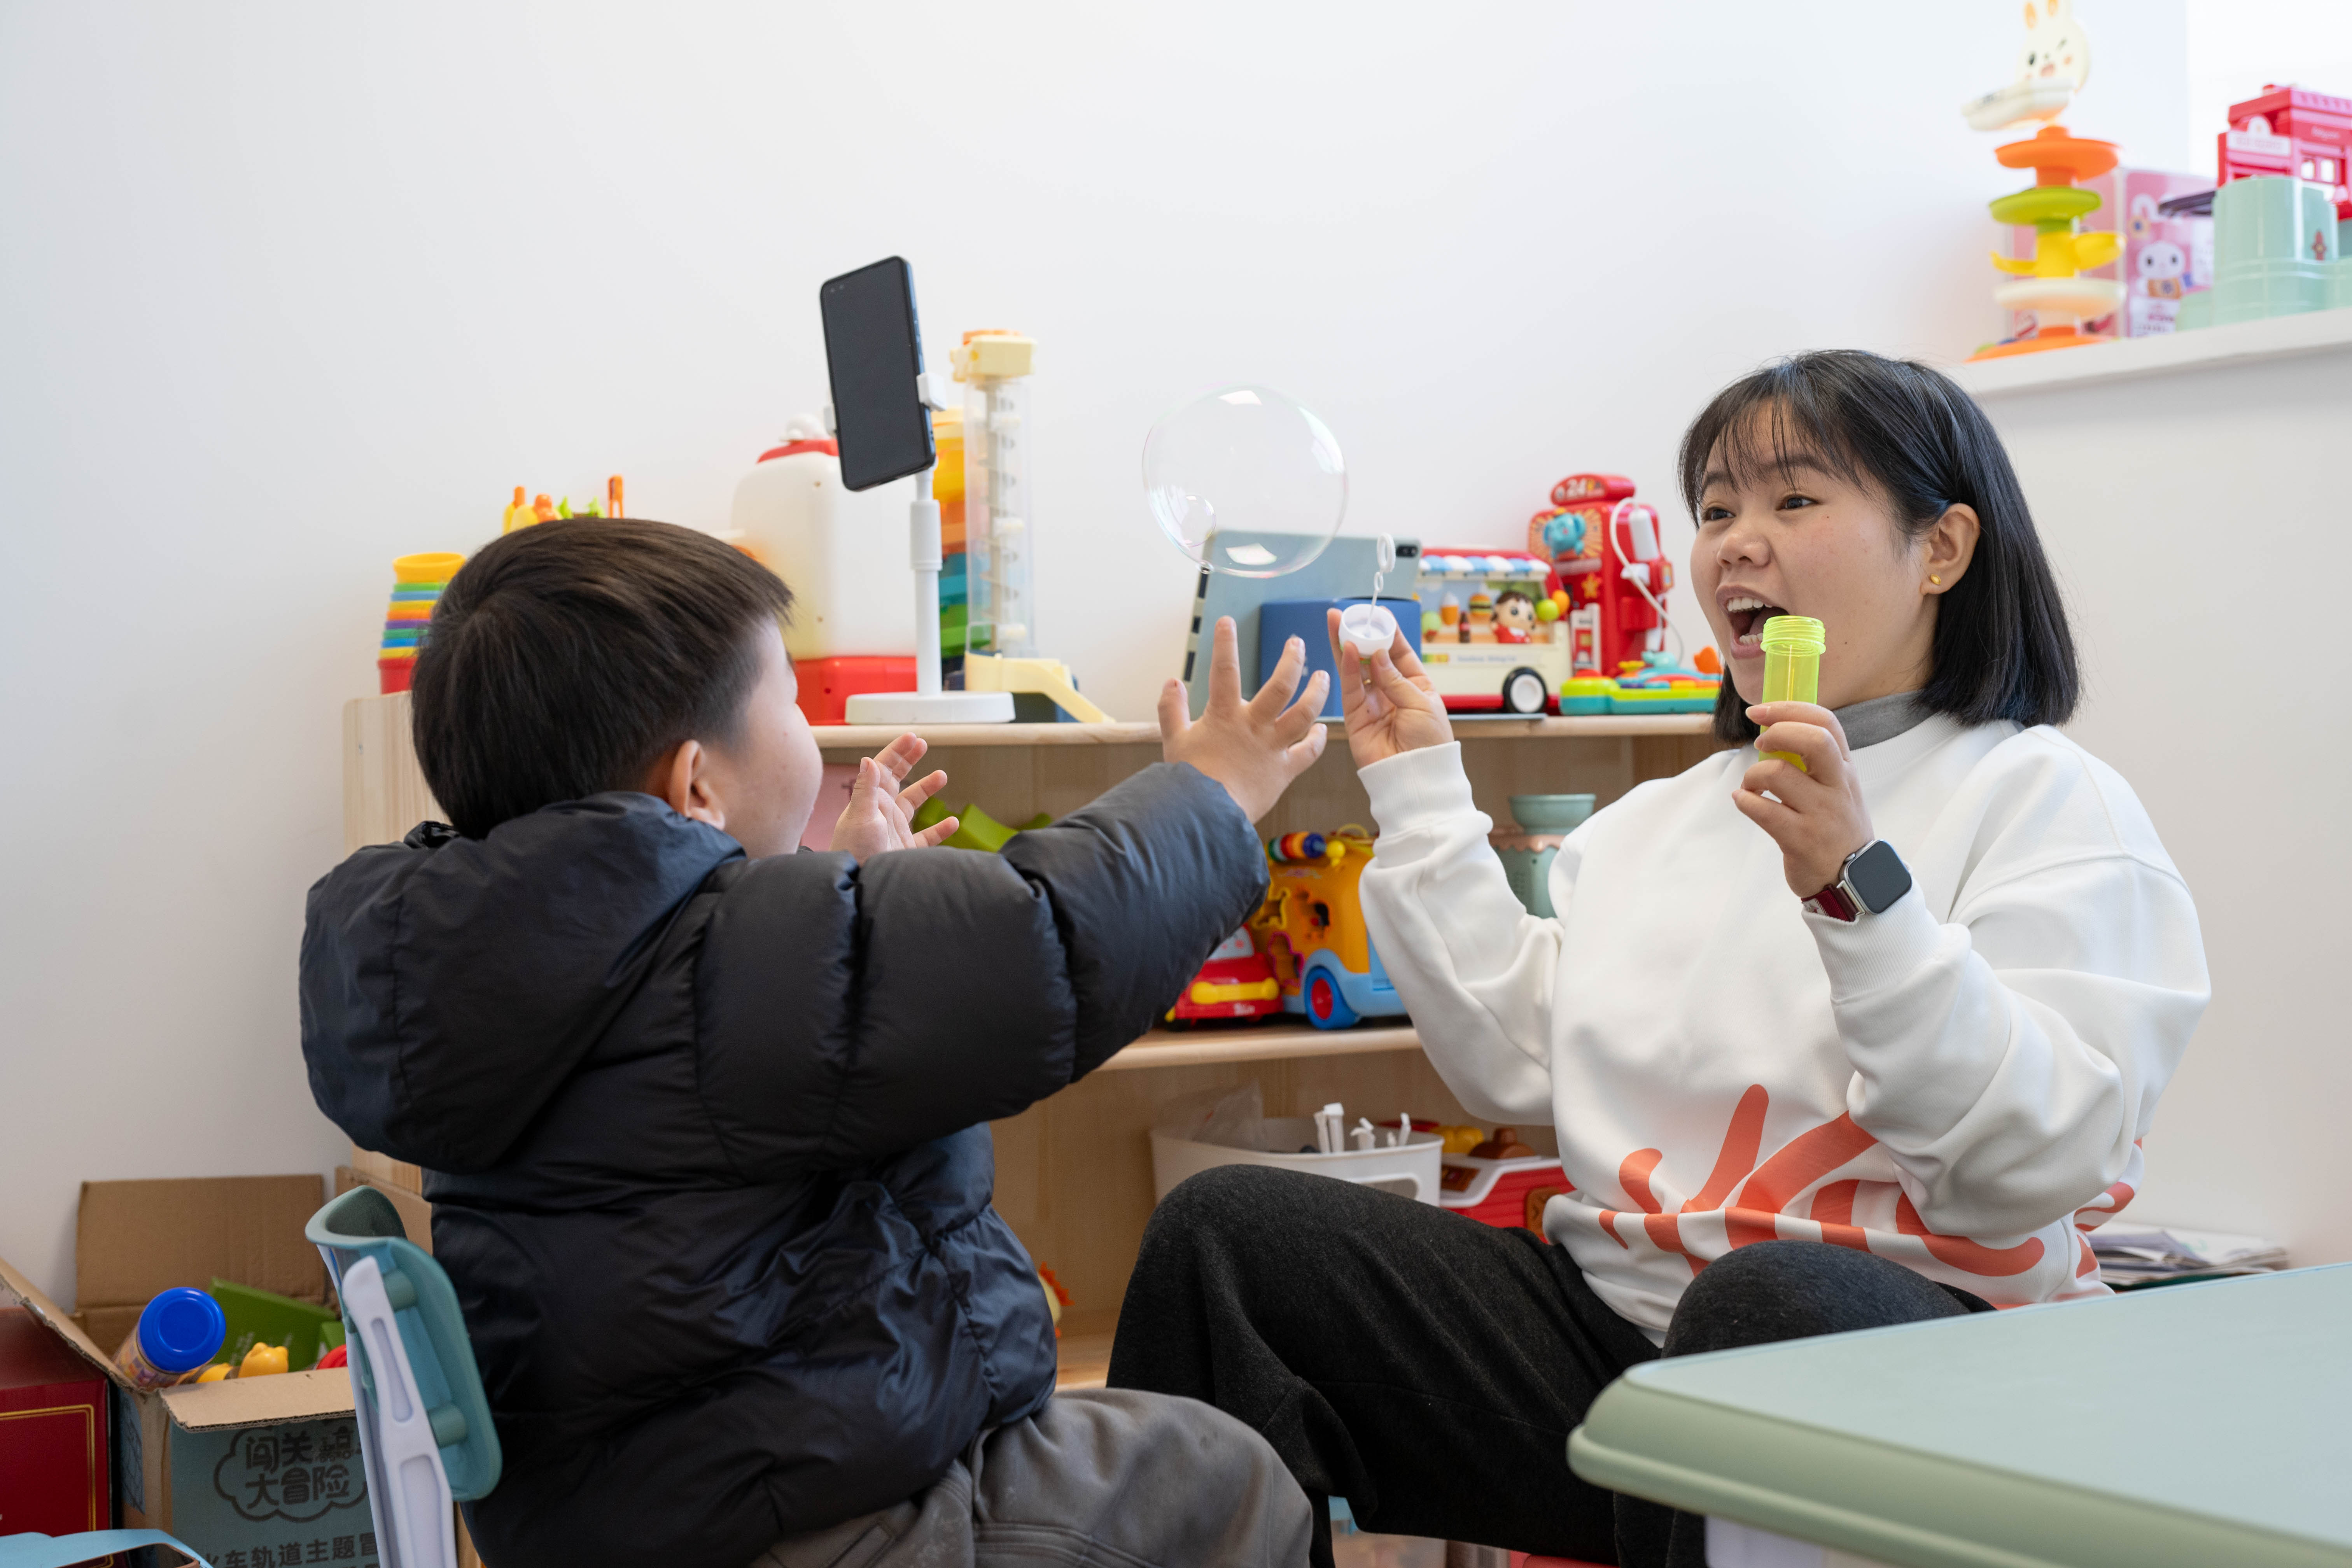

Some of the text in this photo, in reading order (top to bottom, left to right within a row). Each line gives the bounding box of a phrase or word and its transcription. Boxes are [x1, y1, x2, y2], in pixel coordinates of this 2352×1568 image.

[246, 1432, 312, 1473] 闯关
[245, 1465, 349, 1509] 大冒险
